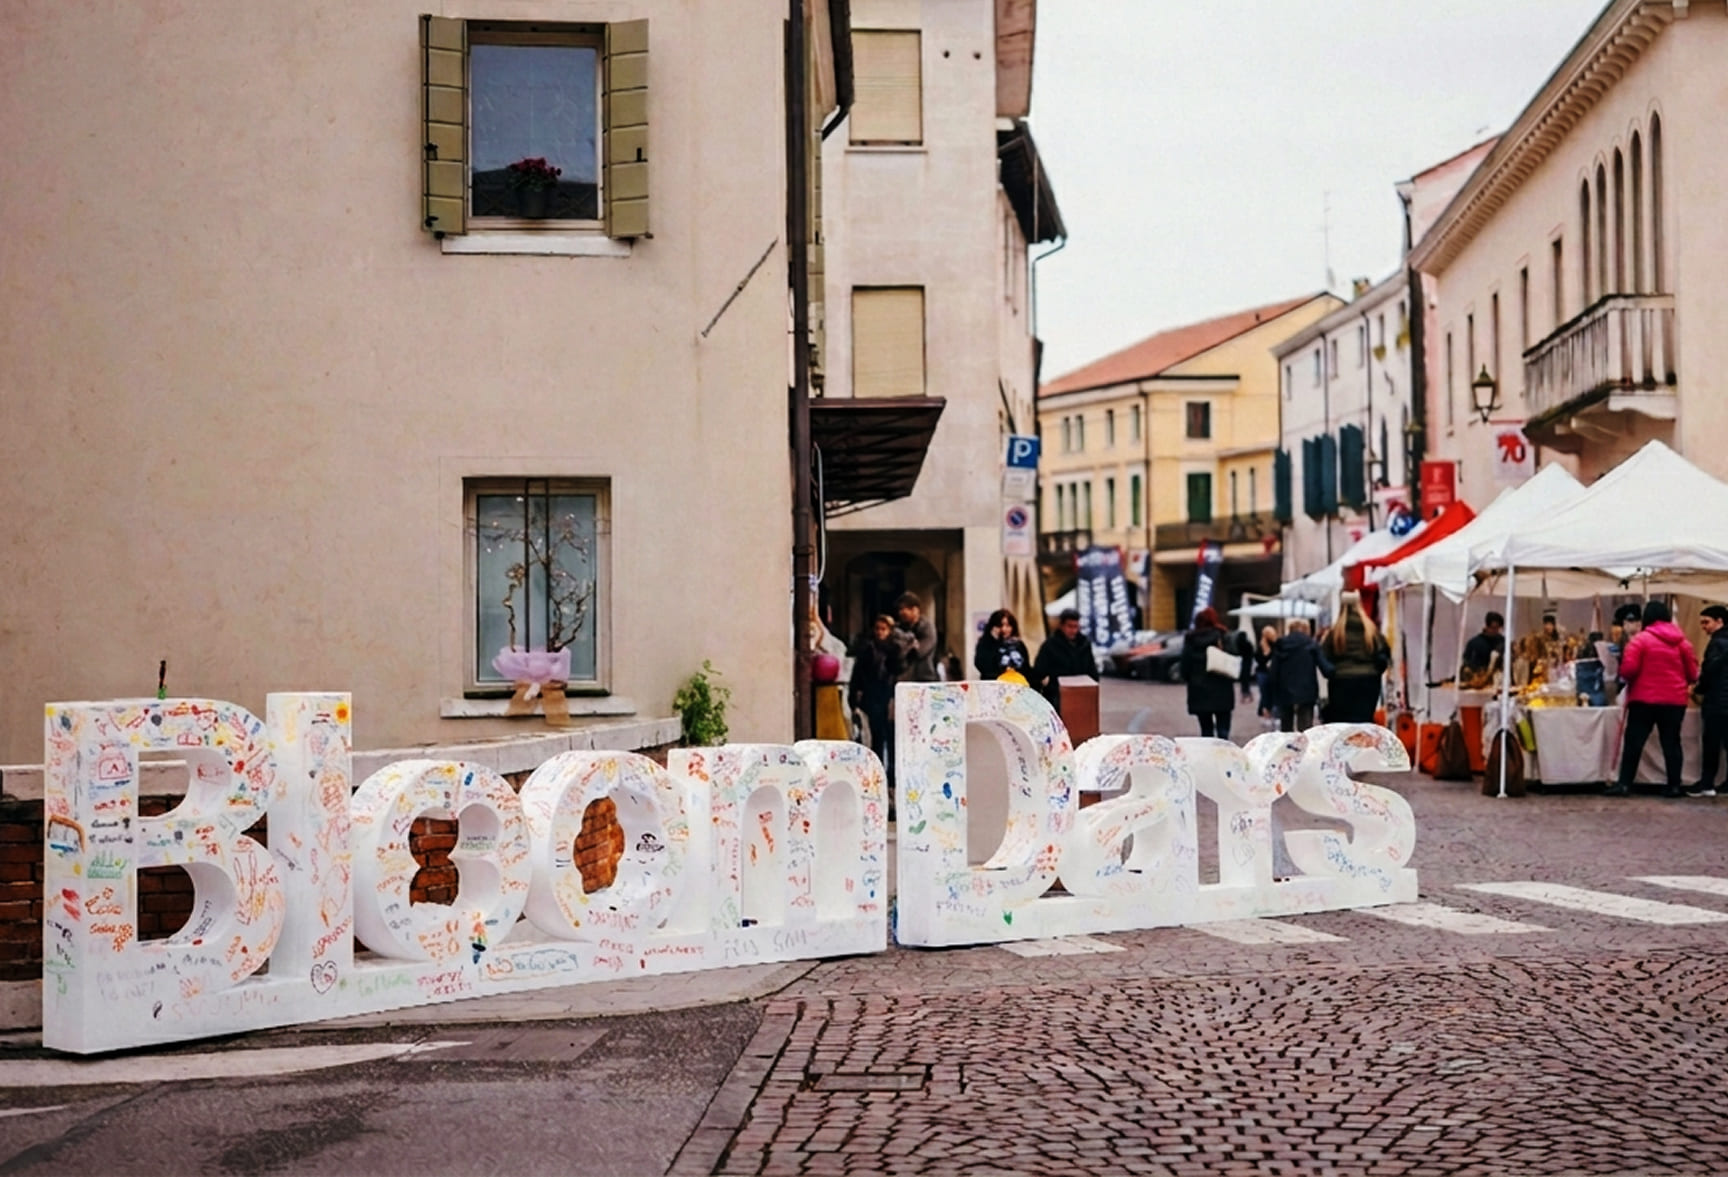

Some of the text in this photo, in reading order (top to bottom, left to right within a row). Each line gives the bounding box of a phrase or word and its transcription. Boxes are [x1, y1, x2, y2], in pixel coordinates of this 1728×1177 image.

[1012, 440, 1032, 464] P
[1497, 433, 1526, 463] 70
[42, 691, 888, 1055] Bloom
